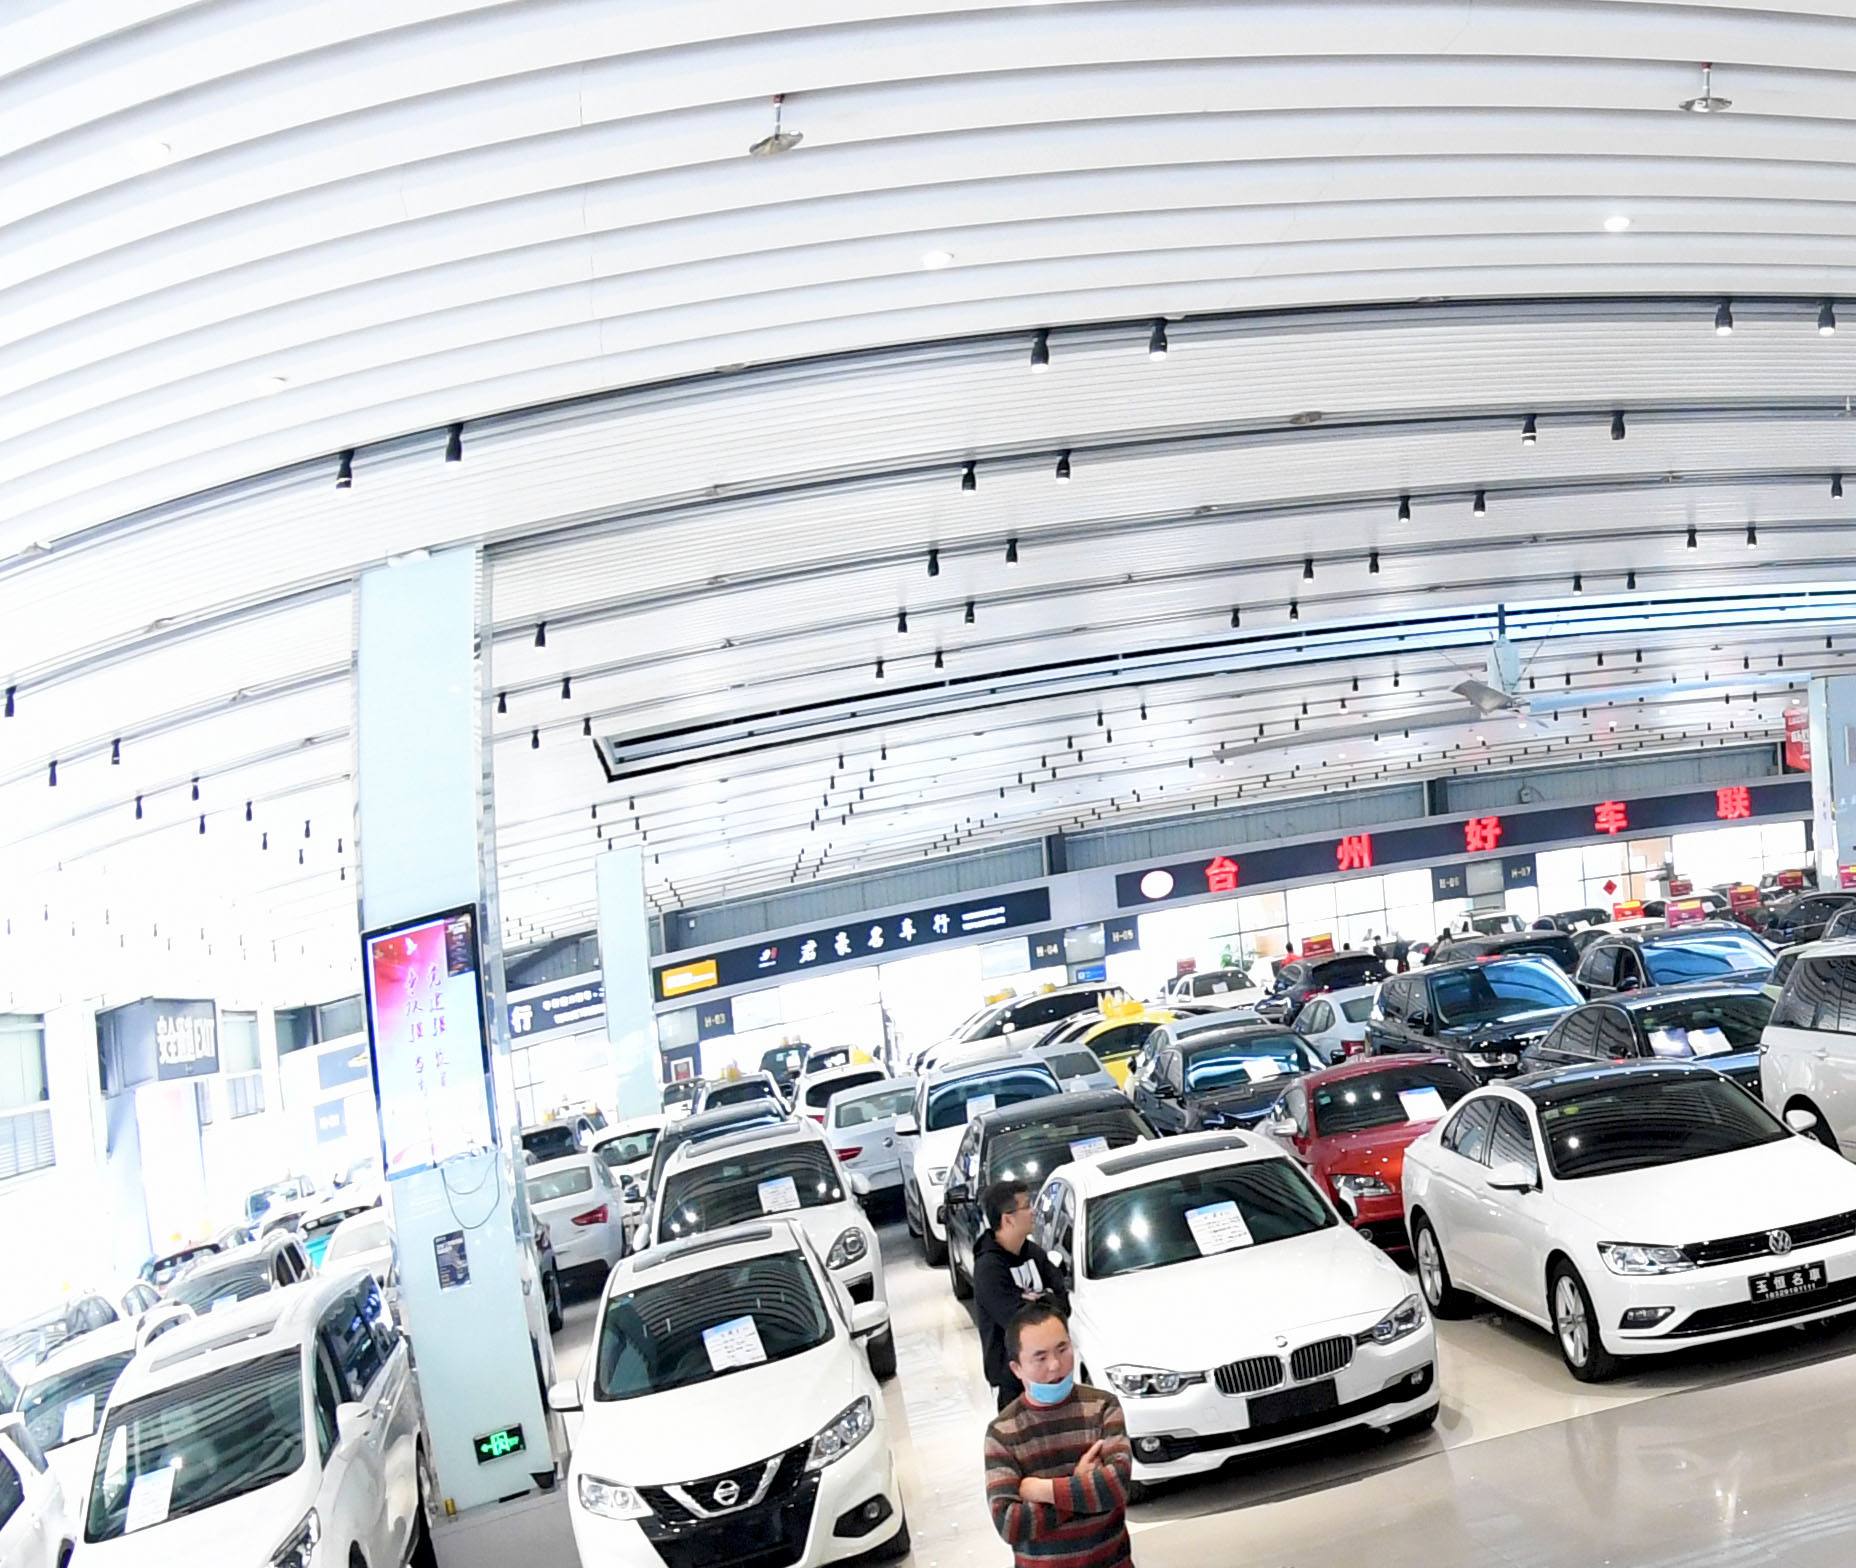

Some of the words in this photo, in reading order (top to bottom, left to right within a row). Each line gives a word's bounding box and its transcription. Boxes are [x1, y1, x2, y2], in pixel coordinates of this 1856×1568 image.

[1205, 785, 1752, 894] 台州好车联
